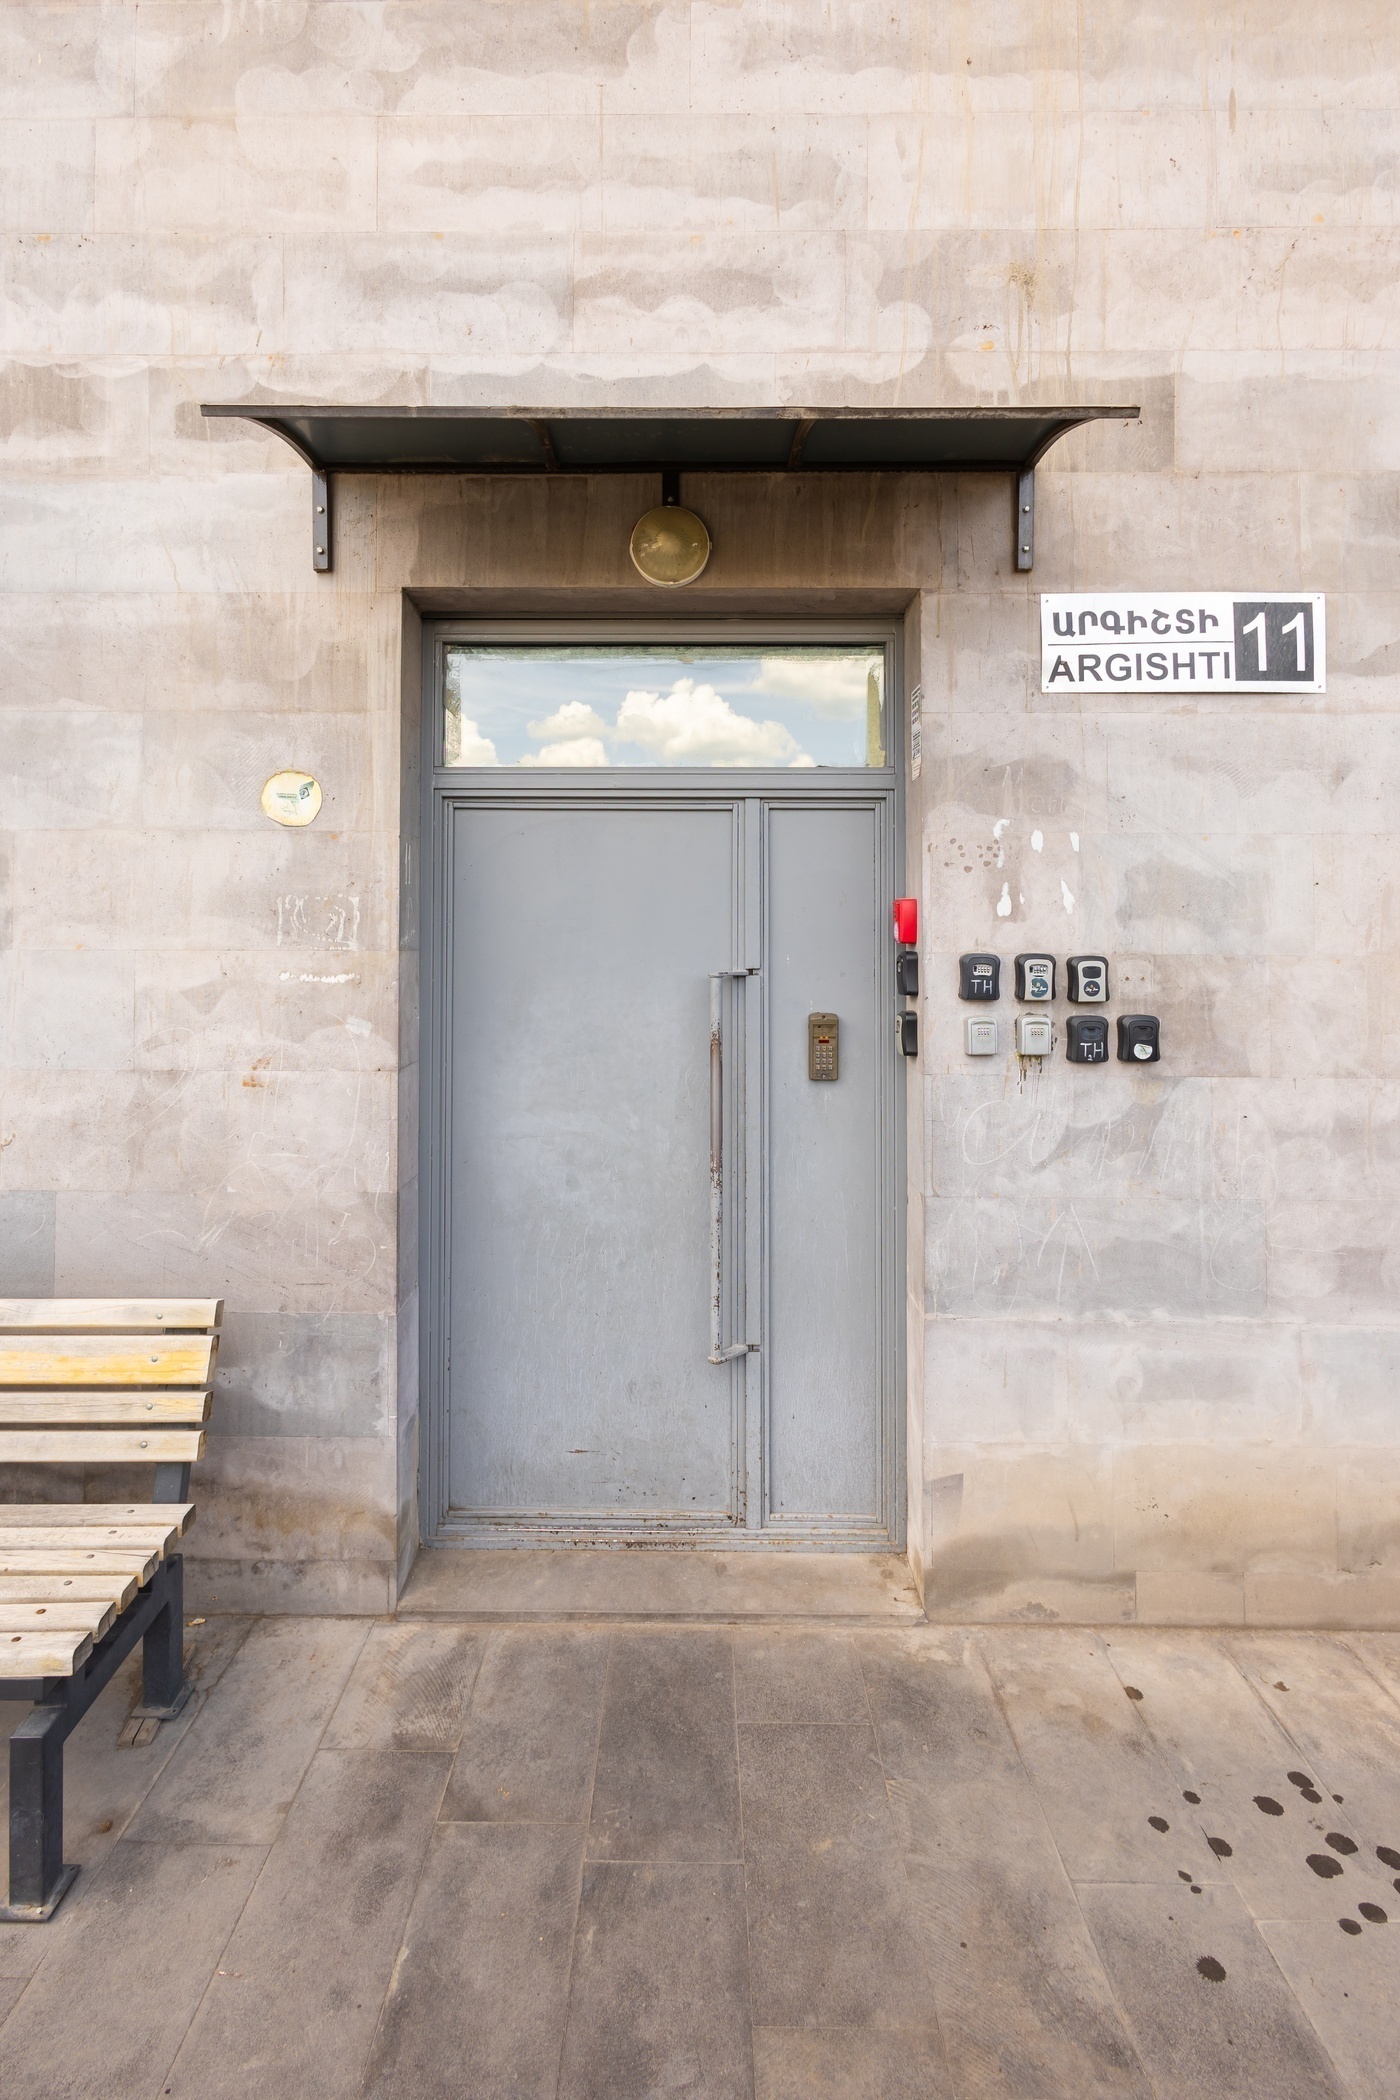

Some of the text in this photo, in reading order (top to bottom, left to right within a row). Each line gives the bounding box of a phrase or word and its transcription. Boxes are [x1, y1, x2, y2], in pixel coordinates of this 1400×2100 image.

[1242, 611, 1307, 672] 11
[1047, 651, 1231, 683] ARGISHTI
[970, 979, 993, 995] TH
